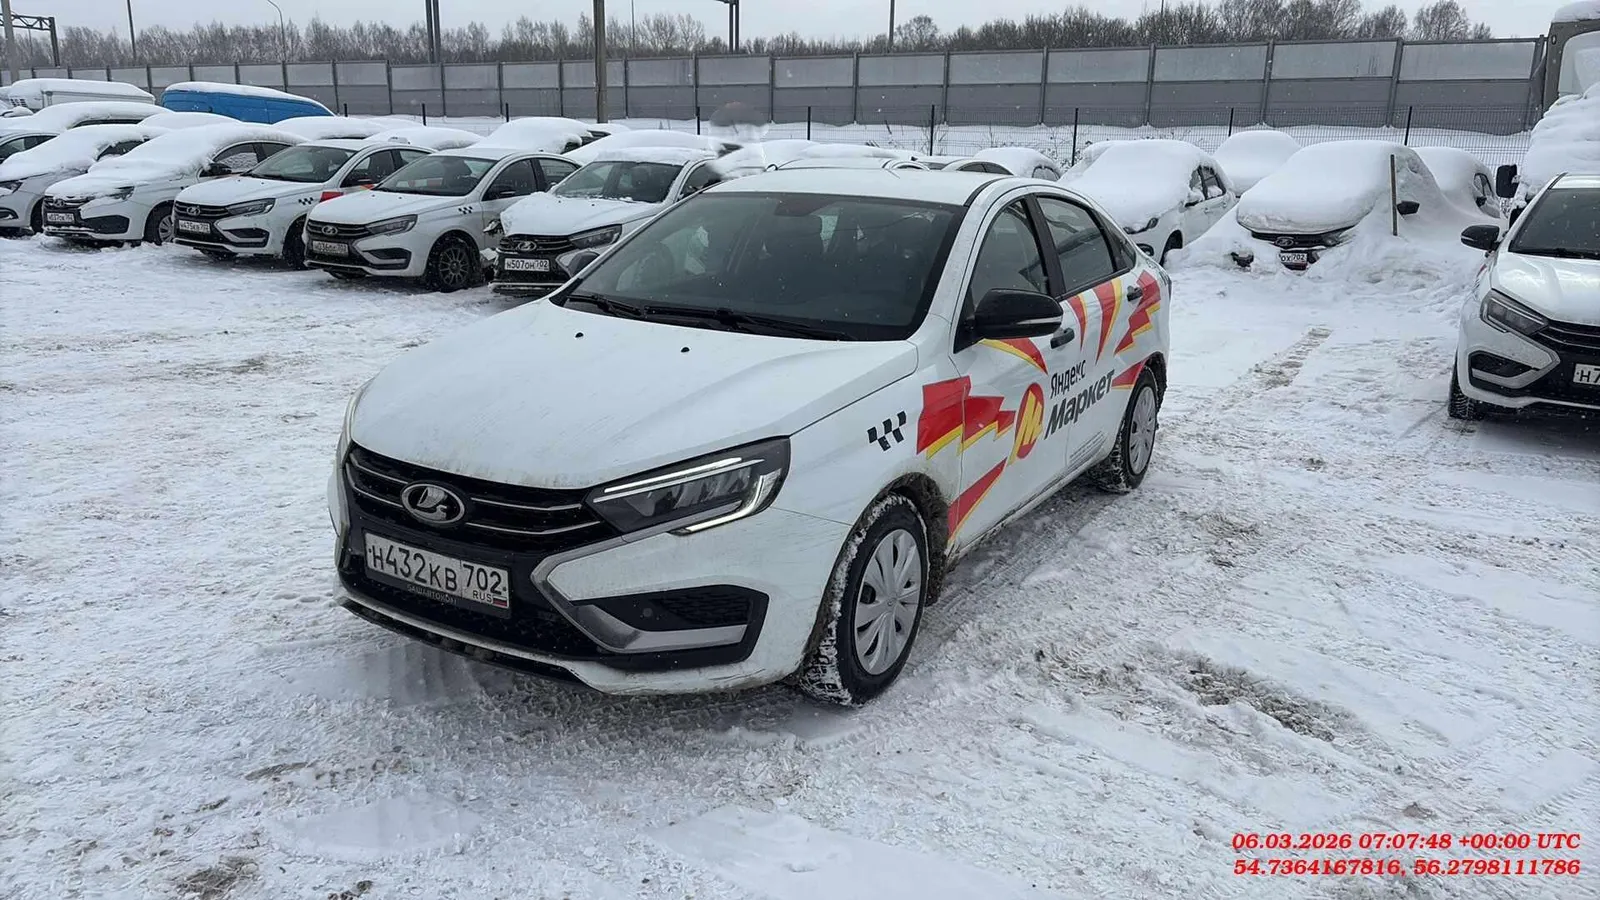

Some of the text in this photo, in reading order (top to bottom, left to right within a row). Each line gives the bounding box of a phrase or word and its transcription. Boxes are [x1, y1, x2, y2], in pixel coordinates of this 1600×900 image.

[506, 259, 548, 270] Н507ОН 702
[1293, 253, 1304, 261] 702
[1050, 360, 1086, 399] Яндекс
[1044, 369, 1115, 440] Маркет
[372, 545, 503, 596] Н432КВ 702
[472, 590, 493, 604] RUS
